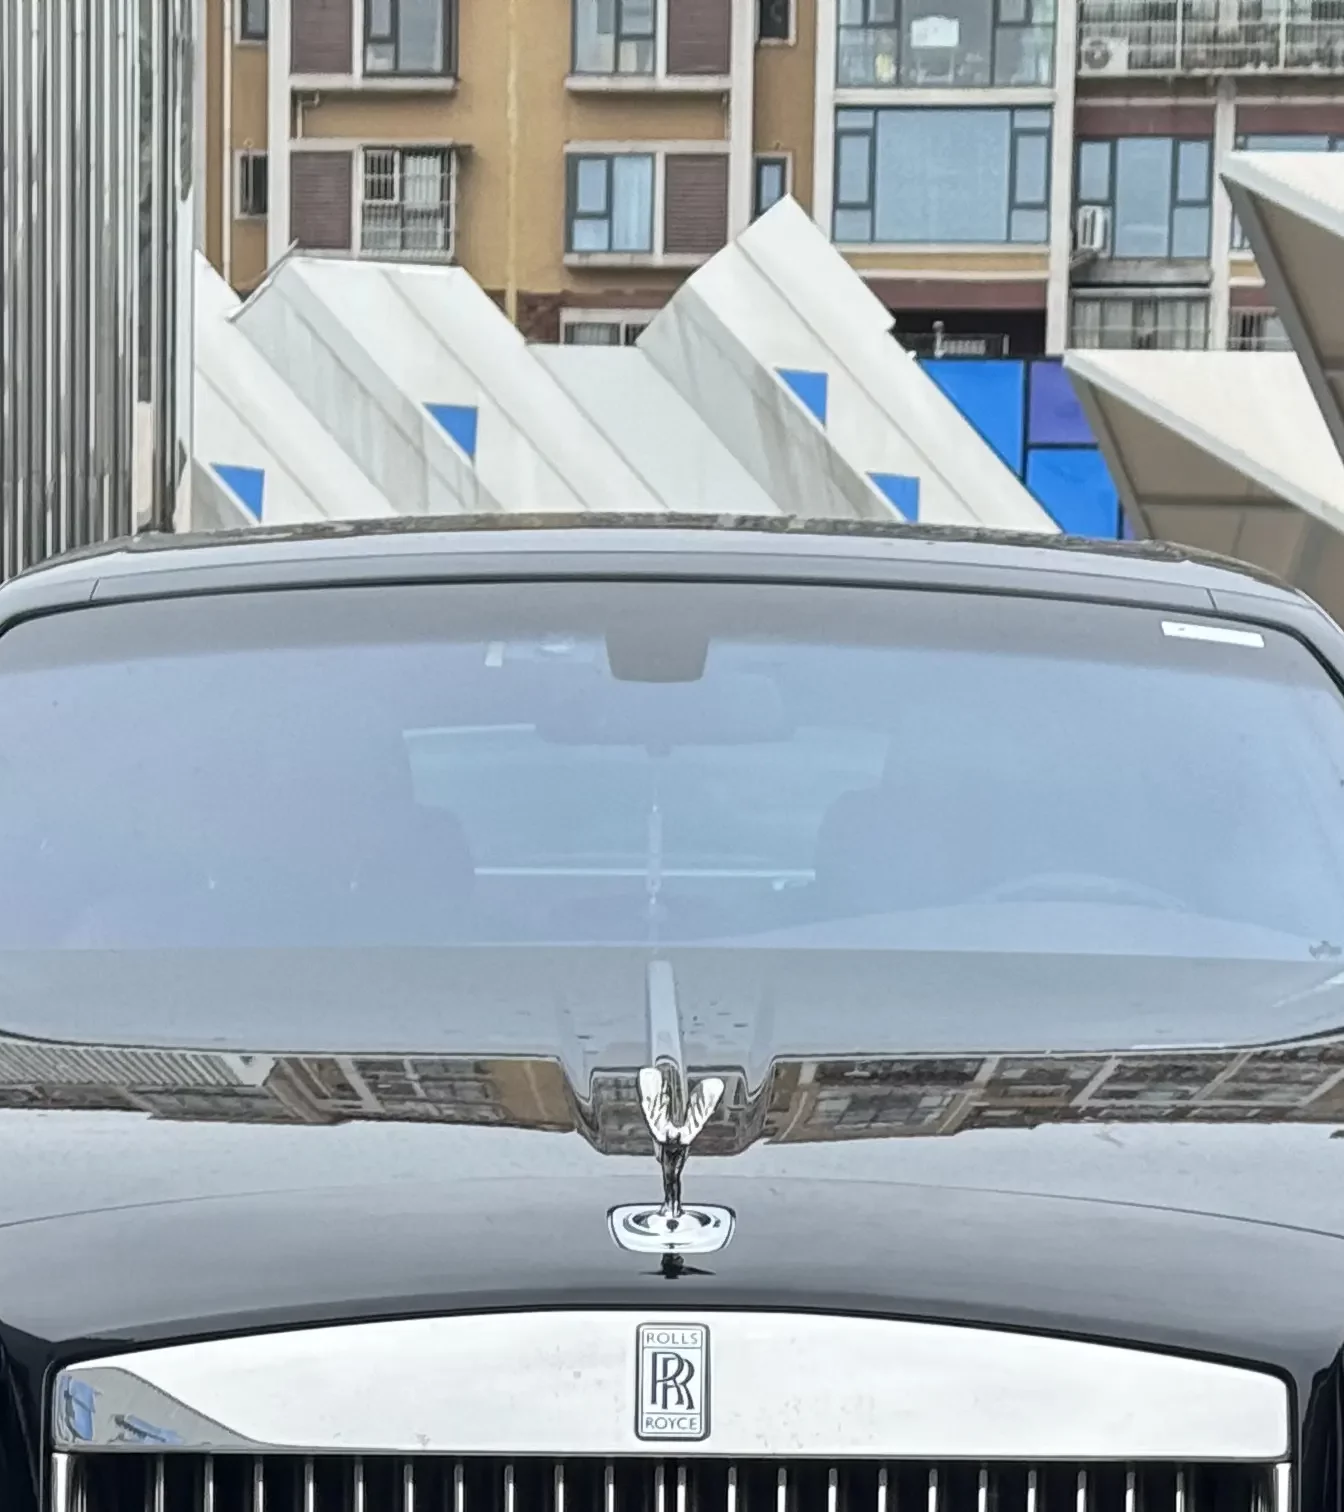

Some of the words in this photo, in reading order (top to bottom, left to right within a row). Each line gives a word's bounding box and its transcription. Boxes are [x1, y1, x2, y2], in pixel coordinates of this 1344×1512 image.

[647, 1332, 698, 1345] ROLLS
[651, 1351, 695, 1410] RR
[645, 1416, 697, 1430] ROYCE
